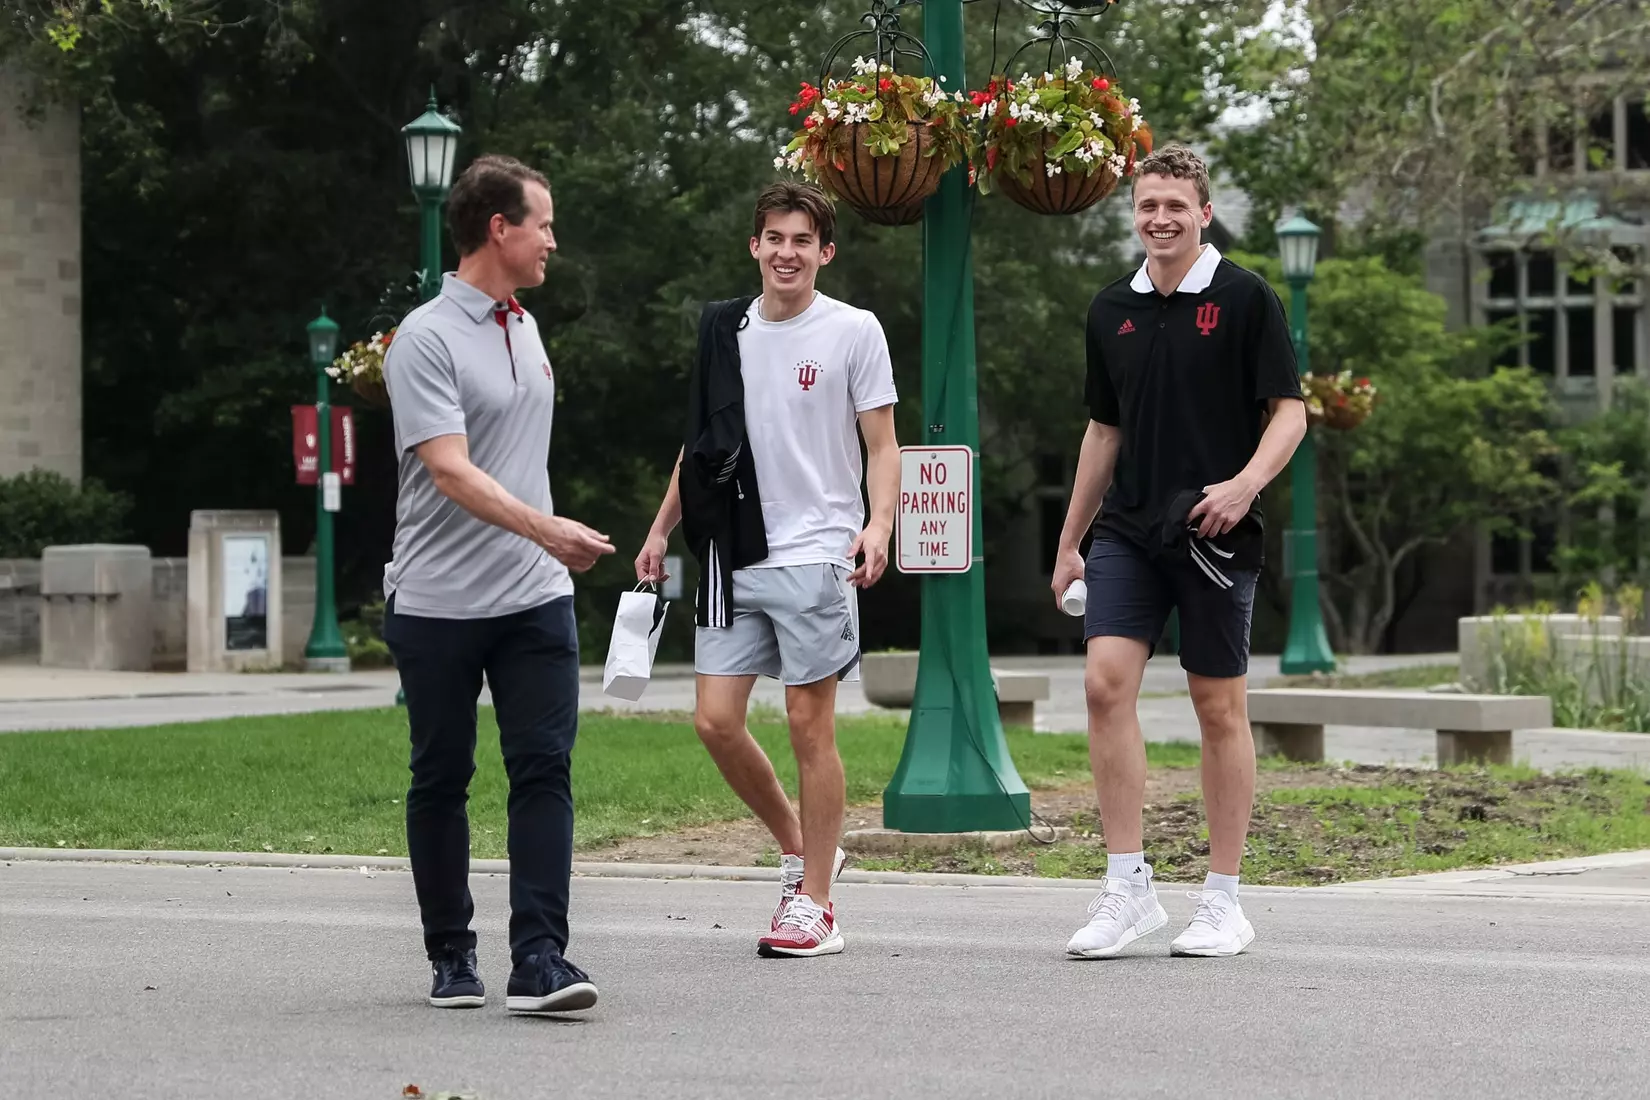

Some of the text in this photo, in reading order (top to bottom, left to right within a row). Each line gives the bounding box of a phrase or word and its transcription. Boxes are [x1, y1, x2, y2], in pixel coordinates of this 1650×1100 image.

[920, 462, 947, 485] NO
[902, 491, 966, 514] PARKING
[920, 520, 947, 535] ANY
[918, 541, 949, 556] TIME
